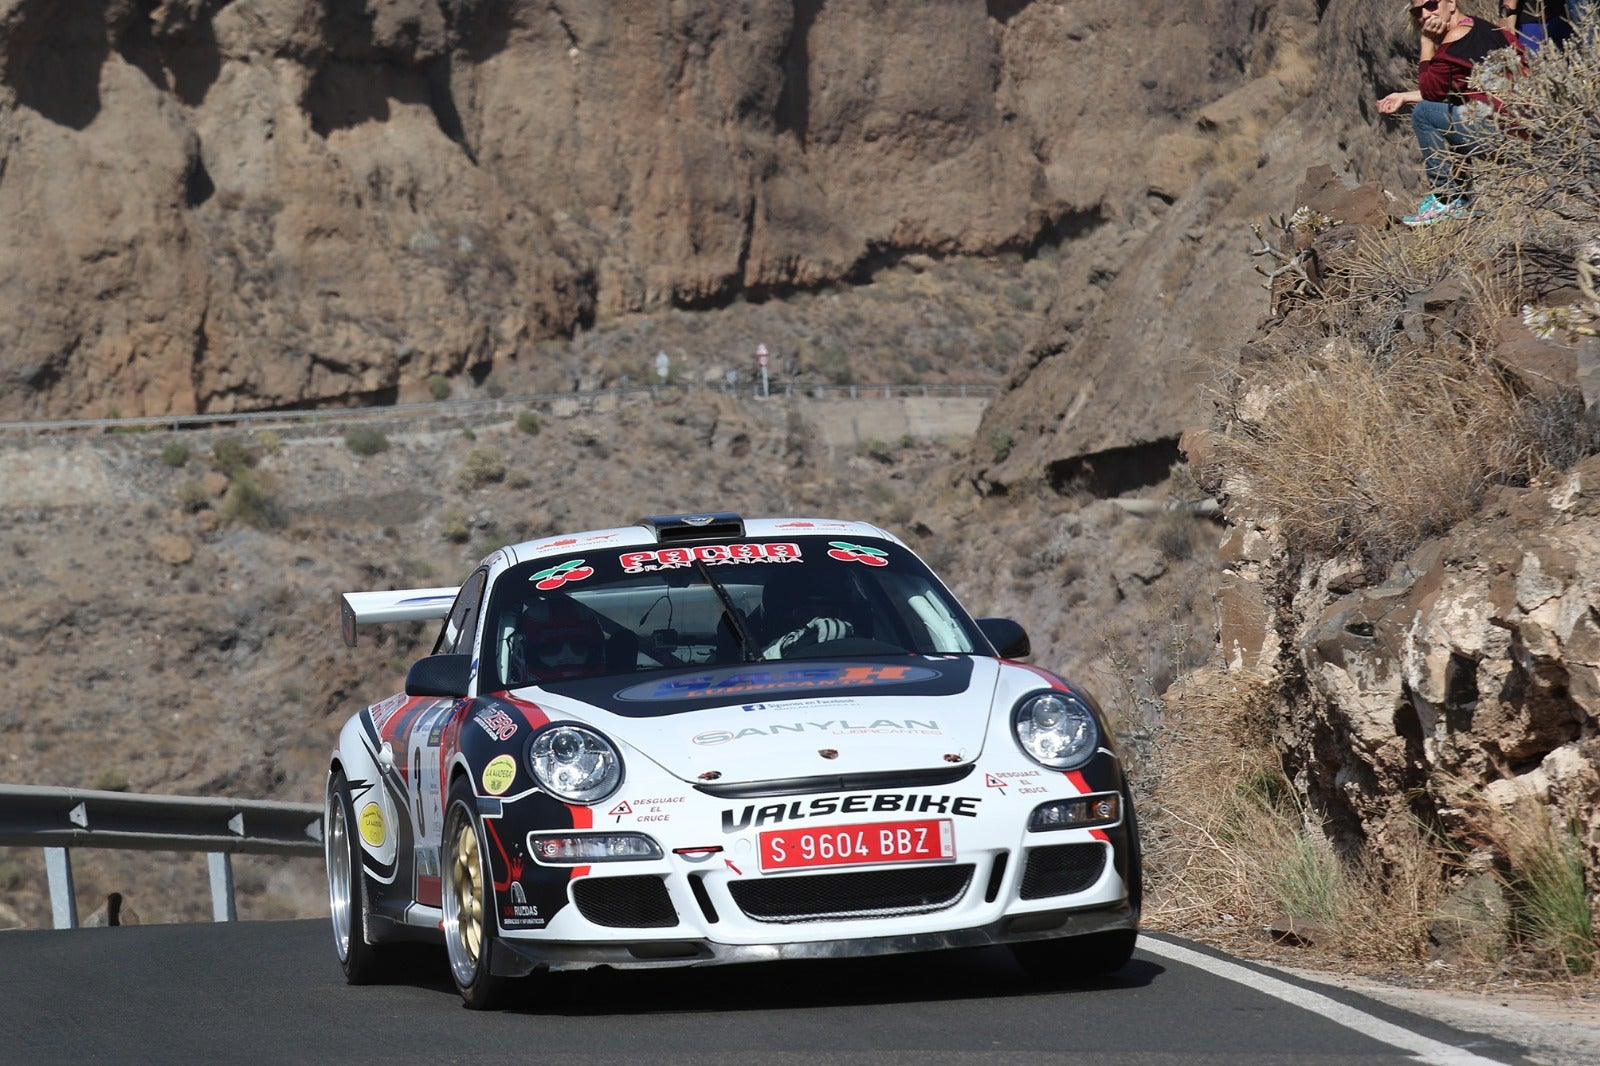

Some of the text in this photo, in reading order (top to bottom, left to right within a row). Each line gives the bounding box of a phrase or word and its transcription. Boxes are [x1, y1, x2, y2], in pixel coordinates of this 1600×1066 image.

[624, 561, 692, 573] GRAN
[485, 709, 518, 741] ZERO
[692, 719, 940, 746] SANYLAN
[633, 796, 686, 806] DESGUACE
[721, 794, 982, 834] VALSEBIKE
[637, 814, 670, 822] CRUCE
[771, 837, 787, 862] S
[800, 831, 869, 860] 9604
[879, 827, 930, 856] BBZ
